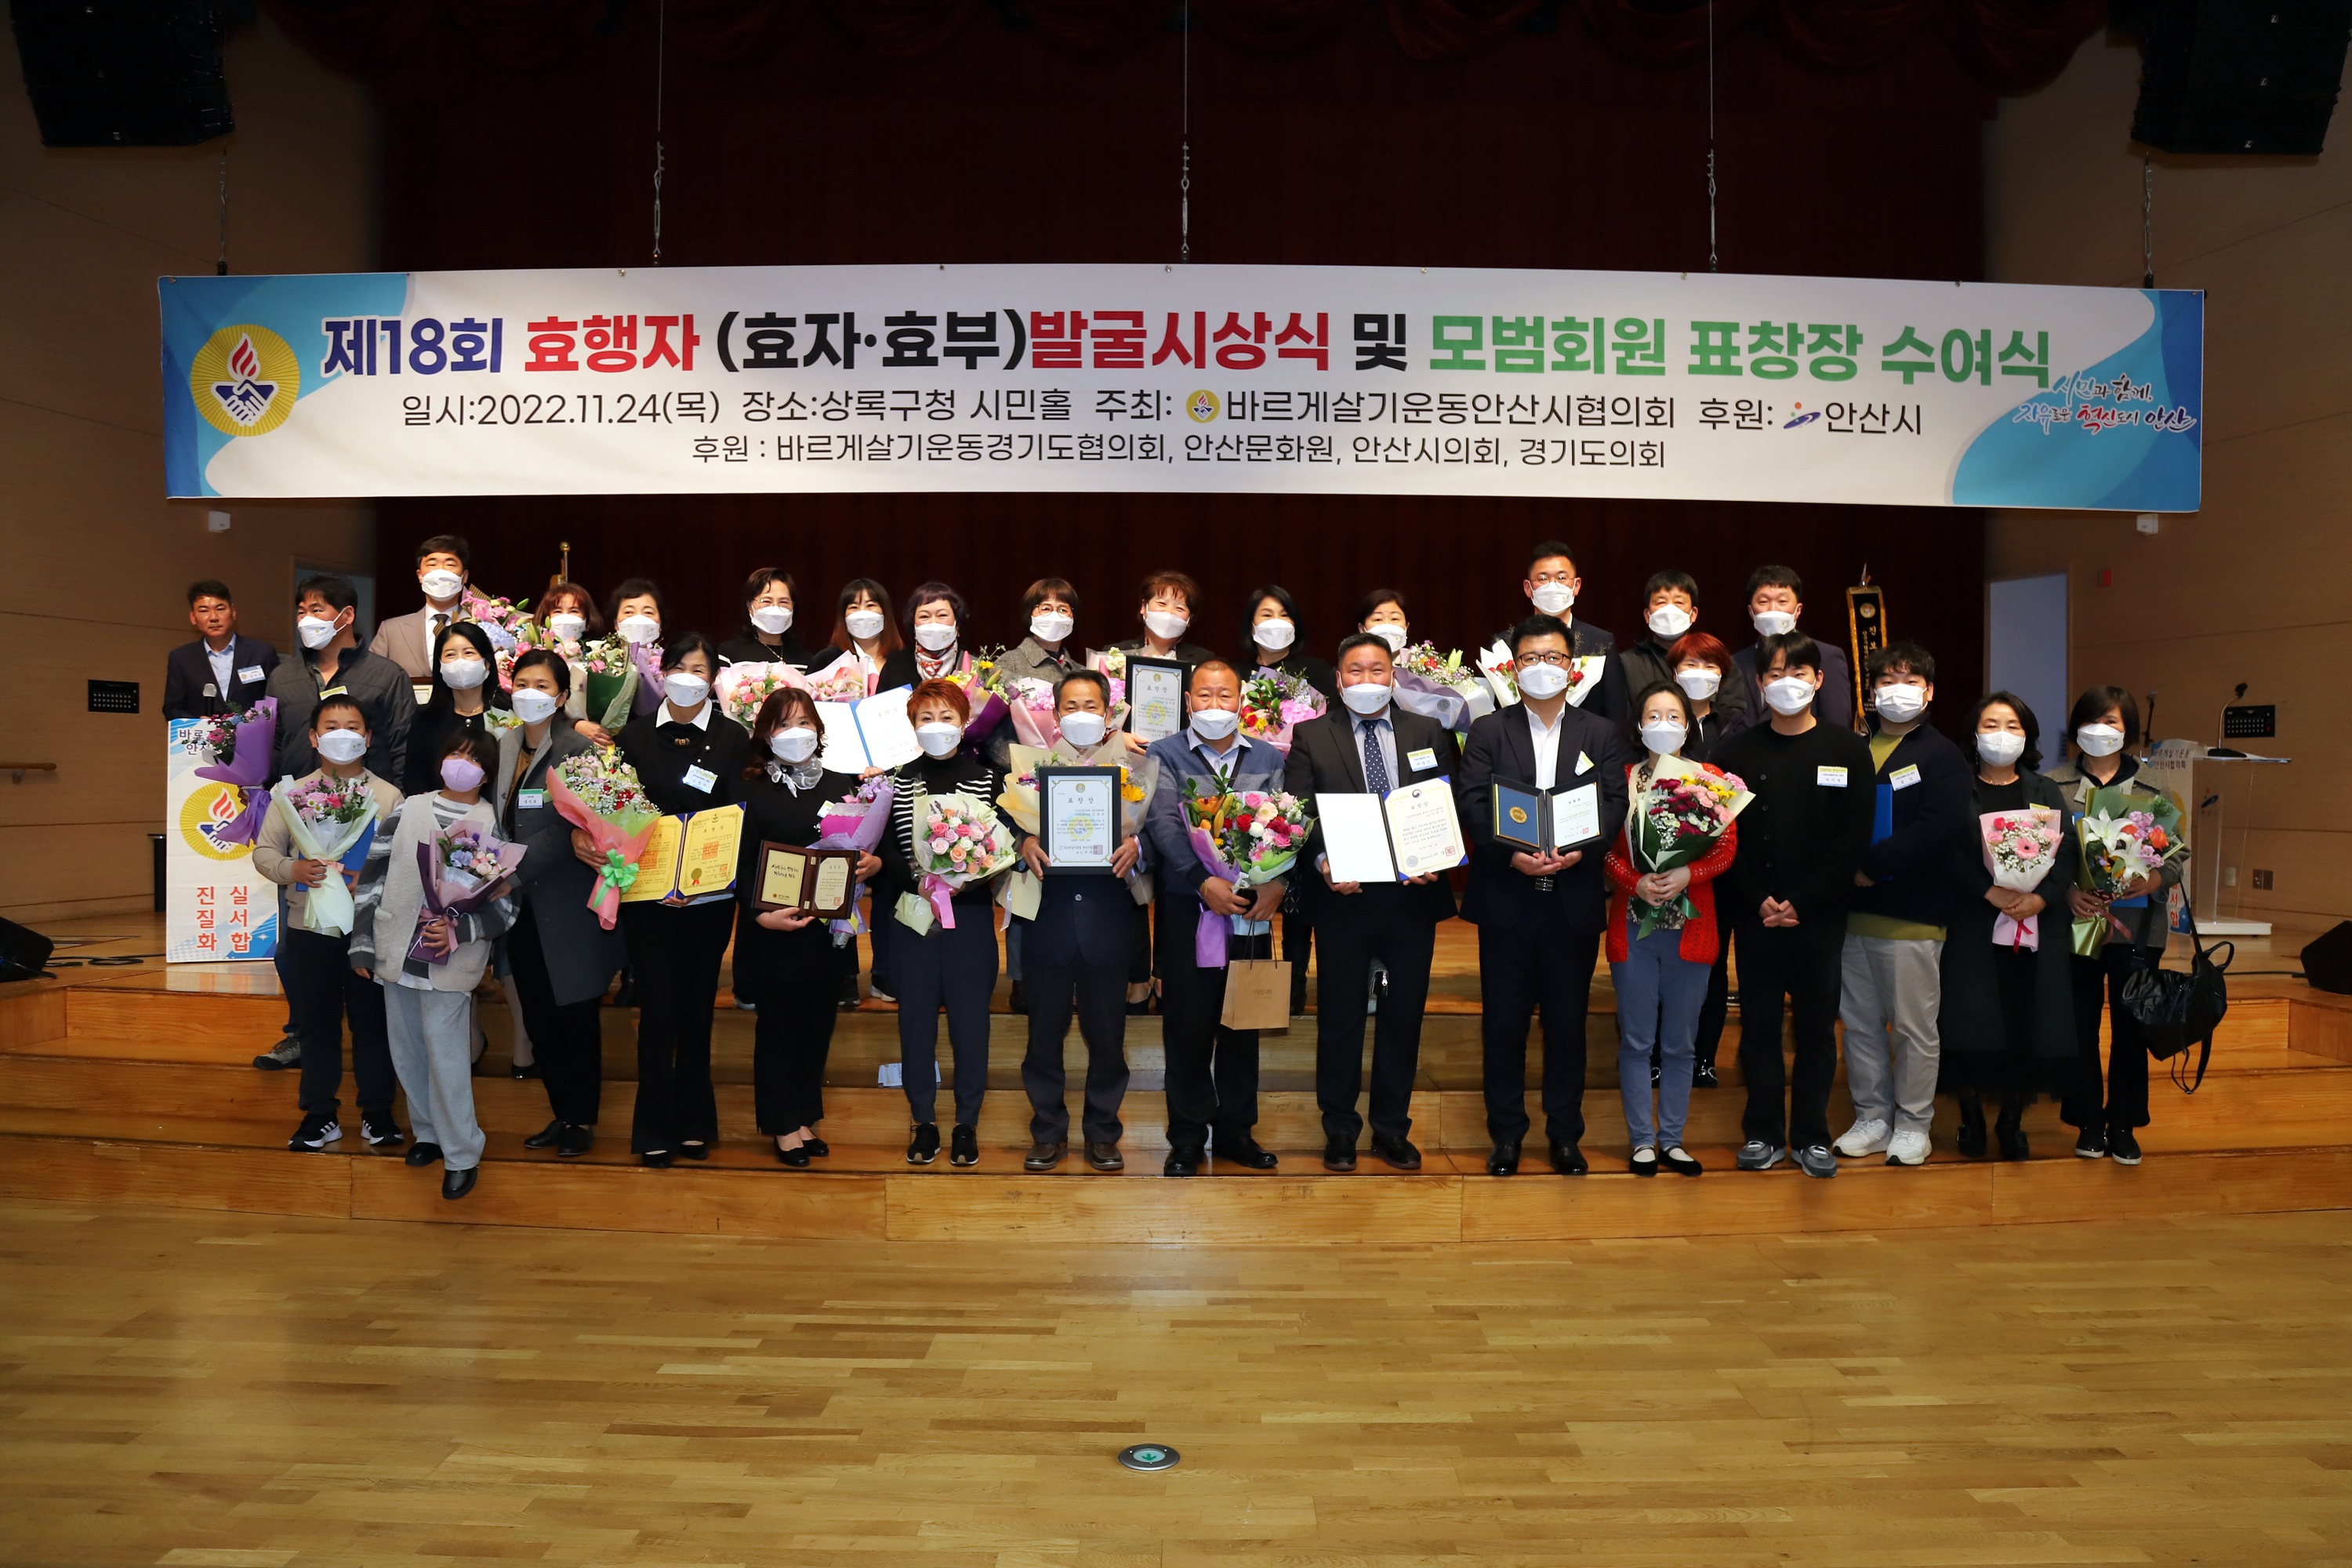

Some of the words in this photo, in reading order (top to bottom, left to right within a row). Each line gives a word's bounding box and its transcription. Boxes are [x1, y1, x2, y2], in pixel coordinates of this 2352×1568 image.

[322, 317, 503, 376] 제18회
[524, 314, 700, 373] 효행자
[1353, 313, 1408, 372] 및
[1430, 316, 1666, 376] 모범회원
[1688, 321, 1862, 381] 표창장
[1882, 325, 2049, 388] 수여식
[2053, 371, 2110, 407] 시민과
[403, 390, 719, 426] 일시:2022.11.24(목)
[742, 389, 955, 422] 장소:상록구청
[970, 388, 1072, 422] 시민홀
[1095, 389, 1173, 422] 주최:
[1228, 390, 1675, 429] 바르게살기운동안산시협의회
[1698, 397, 1773, 431] 후원:
[1825, 402, 1922, 436] 안산시
[2014, 405, 2071, 434] 자유로운
[2078, 405, 2138, 434] 혁신도시
[2145, 408, 2196, 430] 안산
[778, 433, 1174, 465] 바르게살기운동경기도협의회,
[1185, 434, 1341, 466] 안산문화원,
[1352, 436, 1508, 468] 안산시의회,
[1520, 439, 1665, 469] 경기도의회
